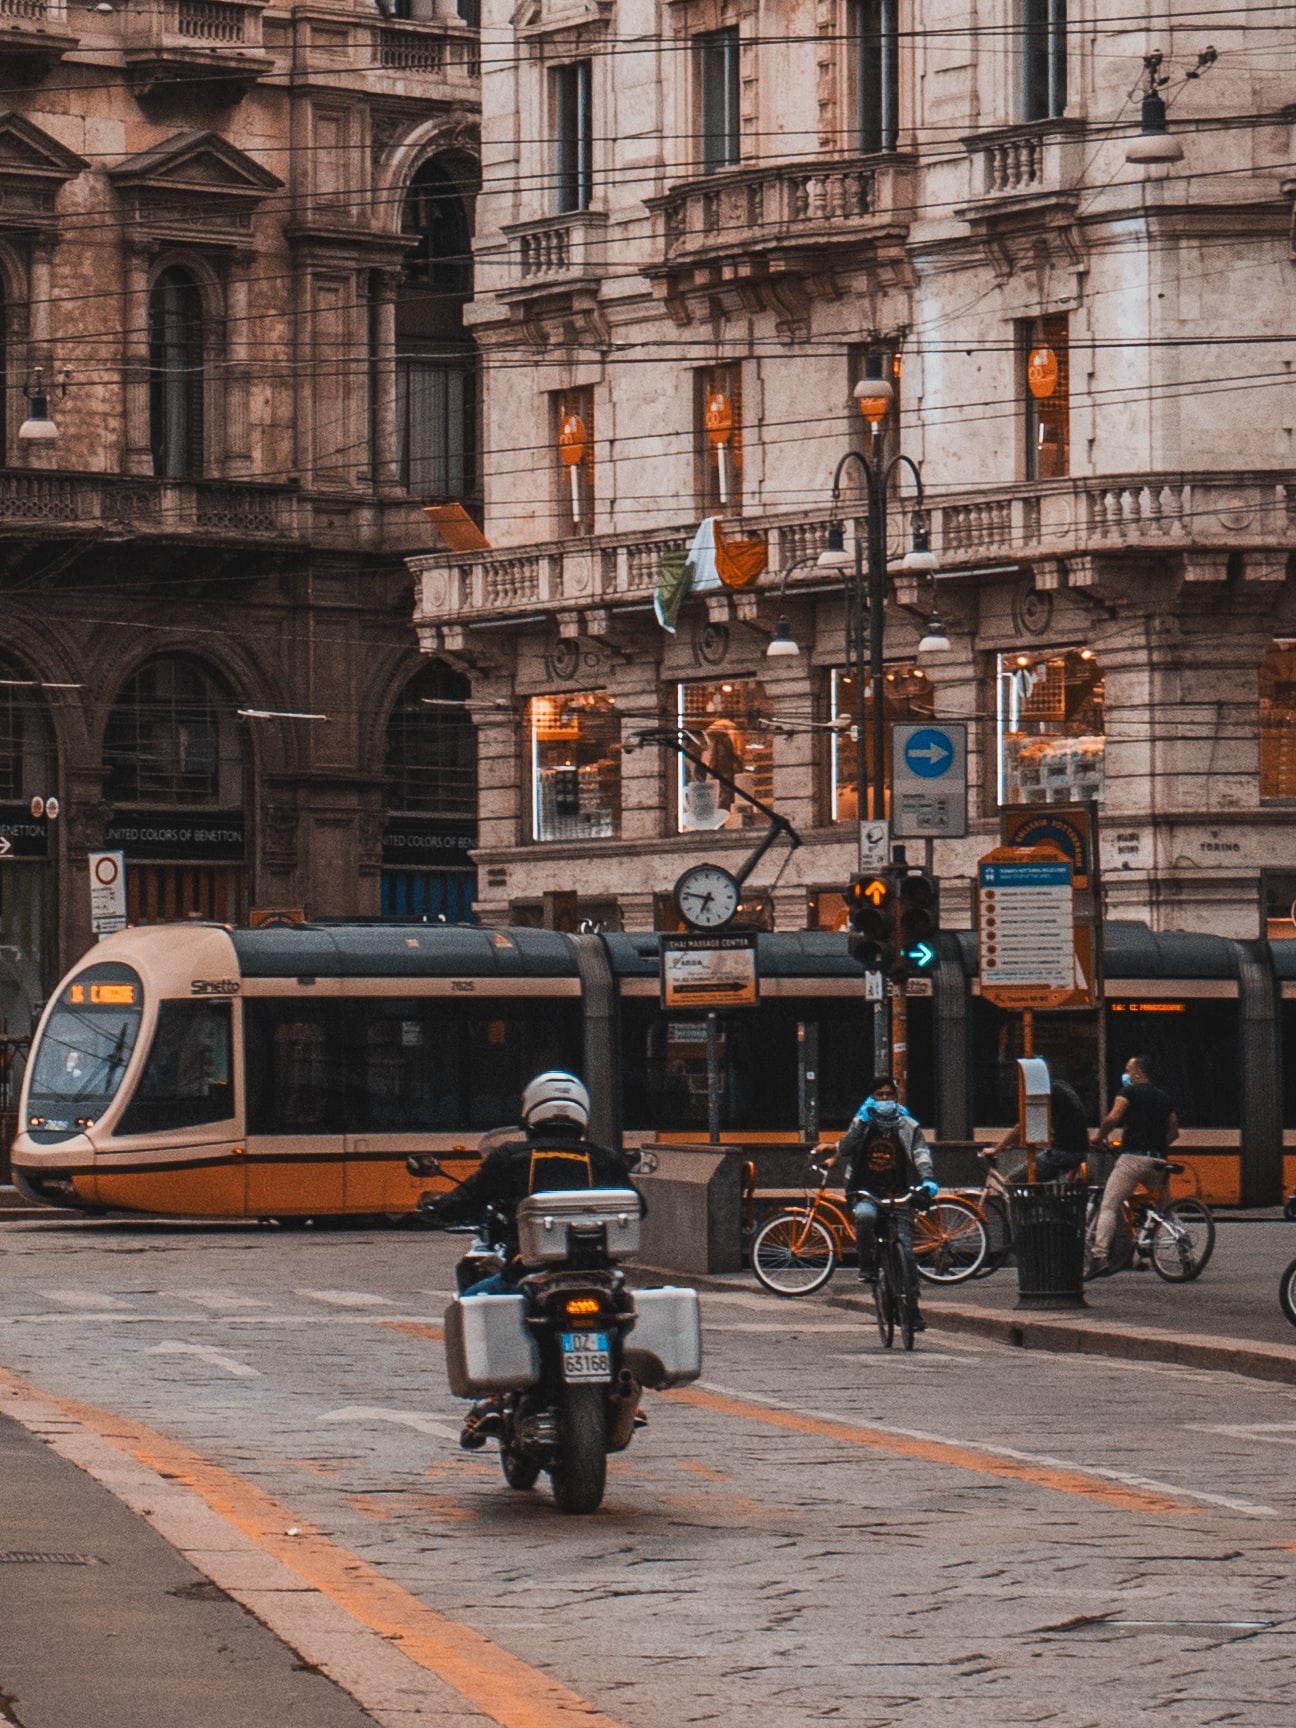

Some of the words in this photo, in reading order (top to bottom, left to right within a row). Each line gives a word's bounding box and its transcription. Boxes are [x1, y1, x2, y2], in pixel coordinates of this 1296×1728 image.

[139, 828, 177, 842] COLORS
[1199, 842, 1241, 853] TORINO
[566, 1355, 607, 1373] 63168
